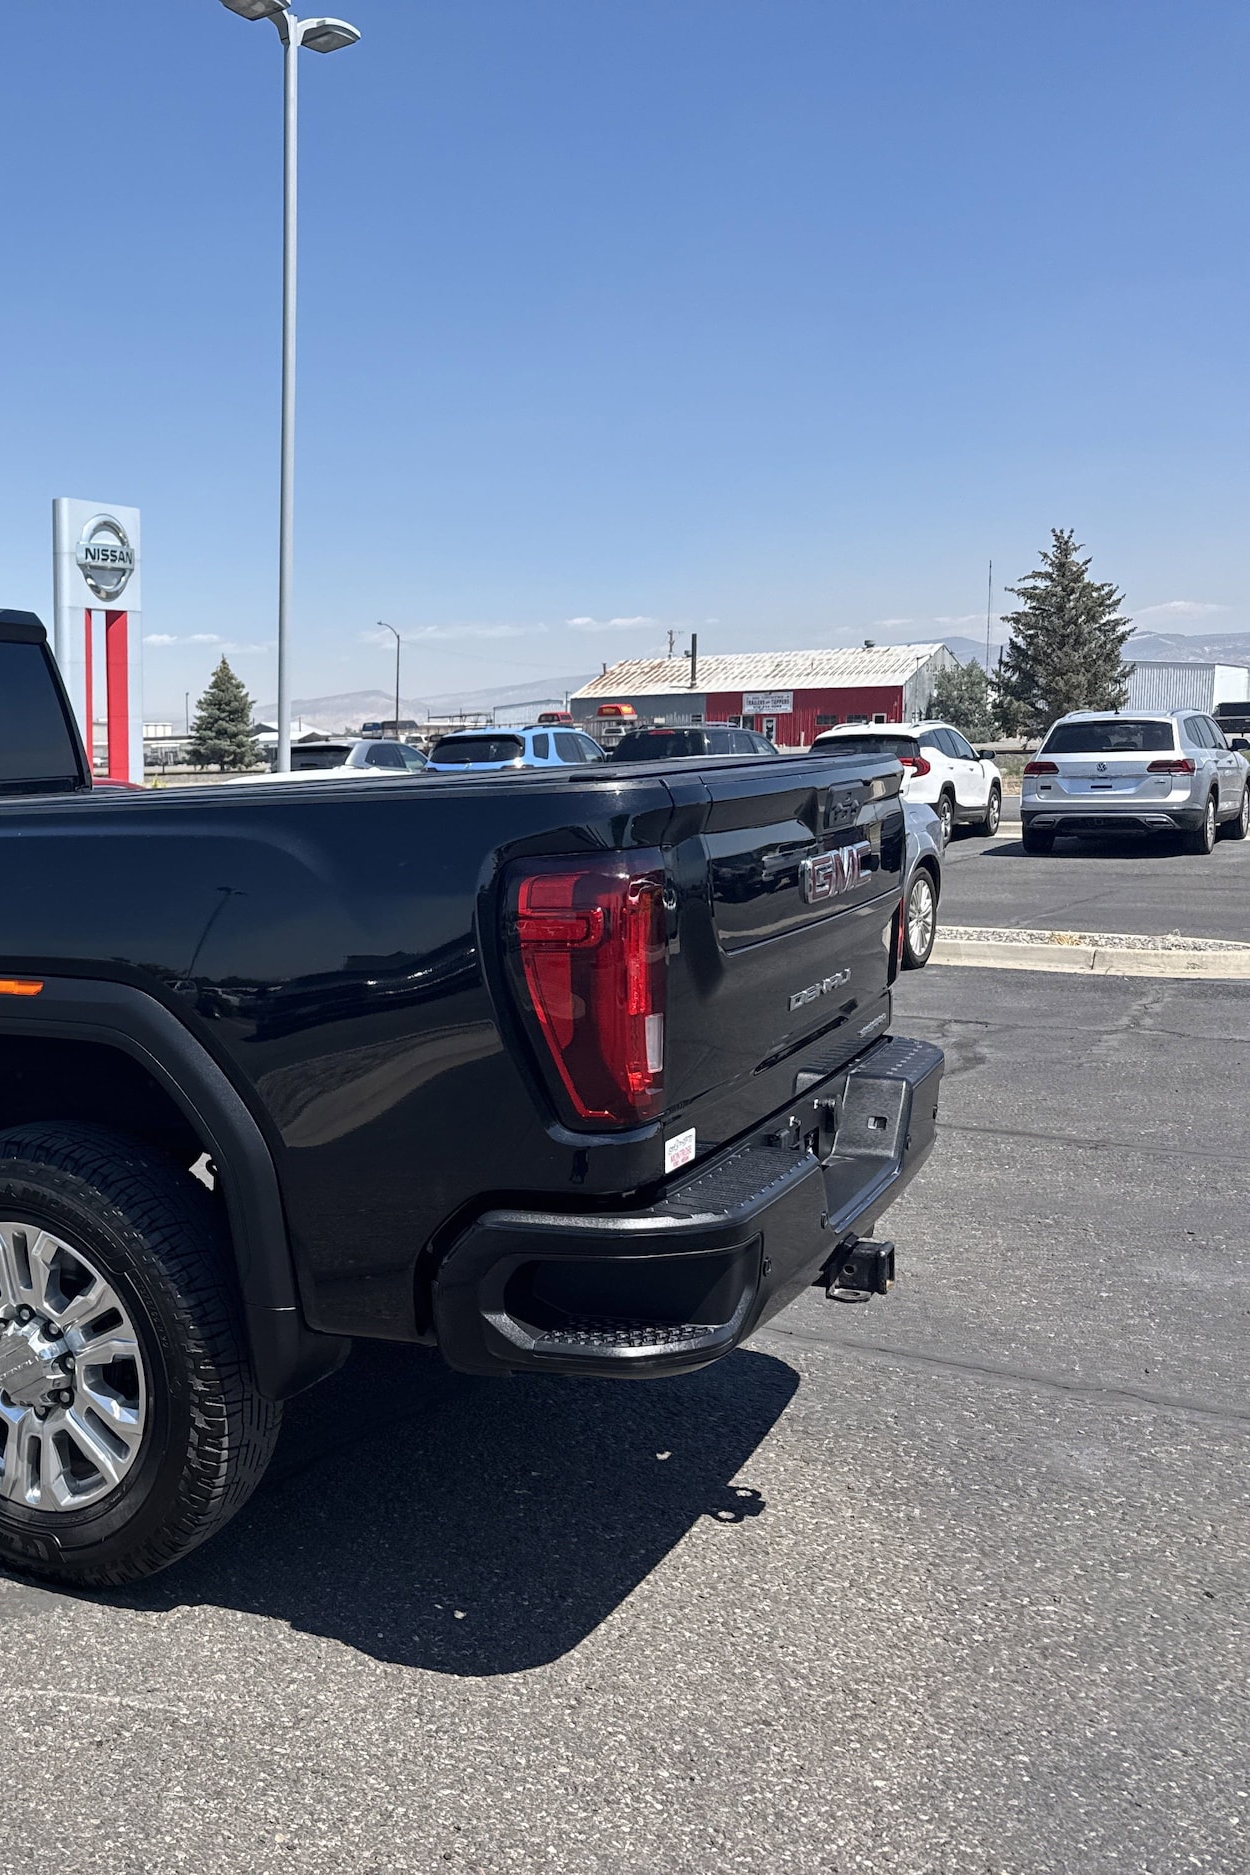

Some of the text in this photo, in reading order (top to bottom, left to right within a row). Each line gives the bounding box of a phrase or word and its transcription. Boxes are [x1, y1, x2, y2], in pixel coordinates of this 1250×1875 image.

[84, 547, 133, 564] NISSAN
[803, 840, 872, 904] GMC
[789, 967, 852, 1012] DENALI
